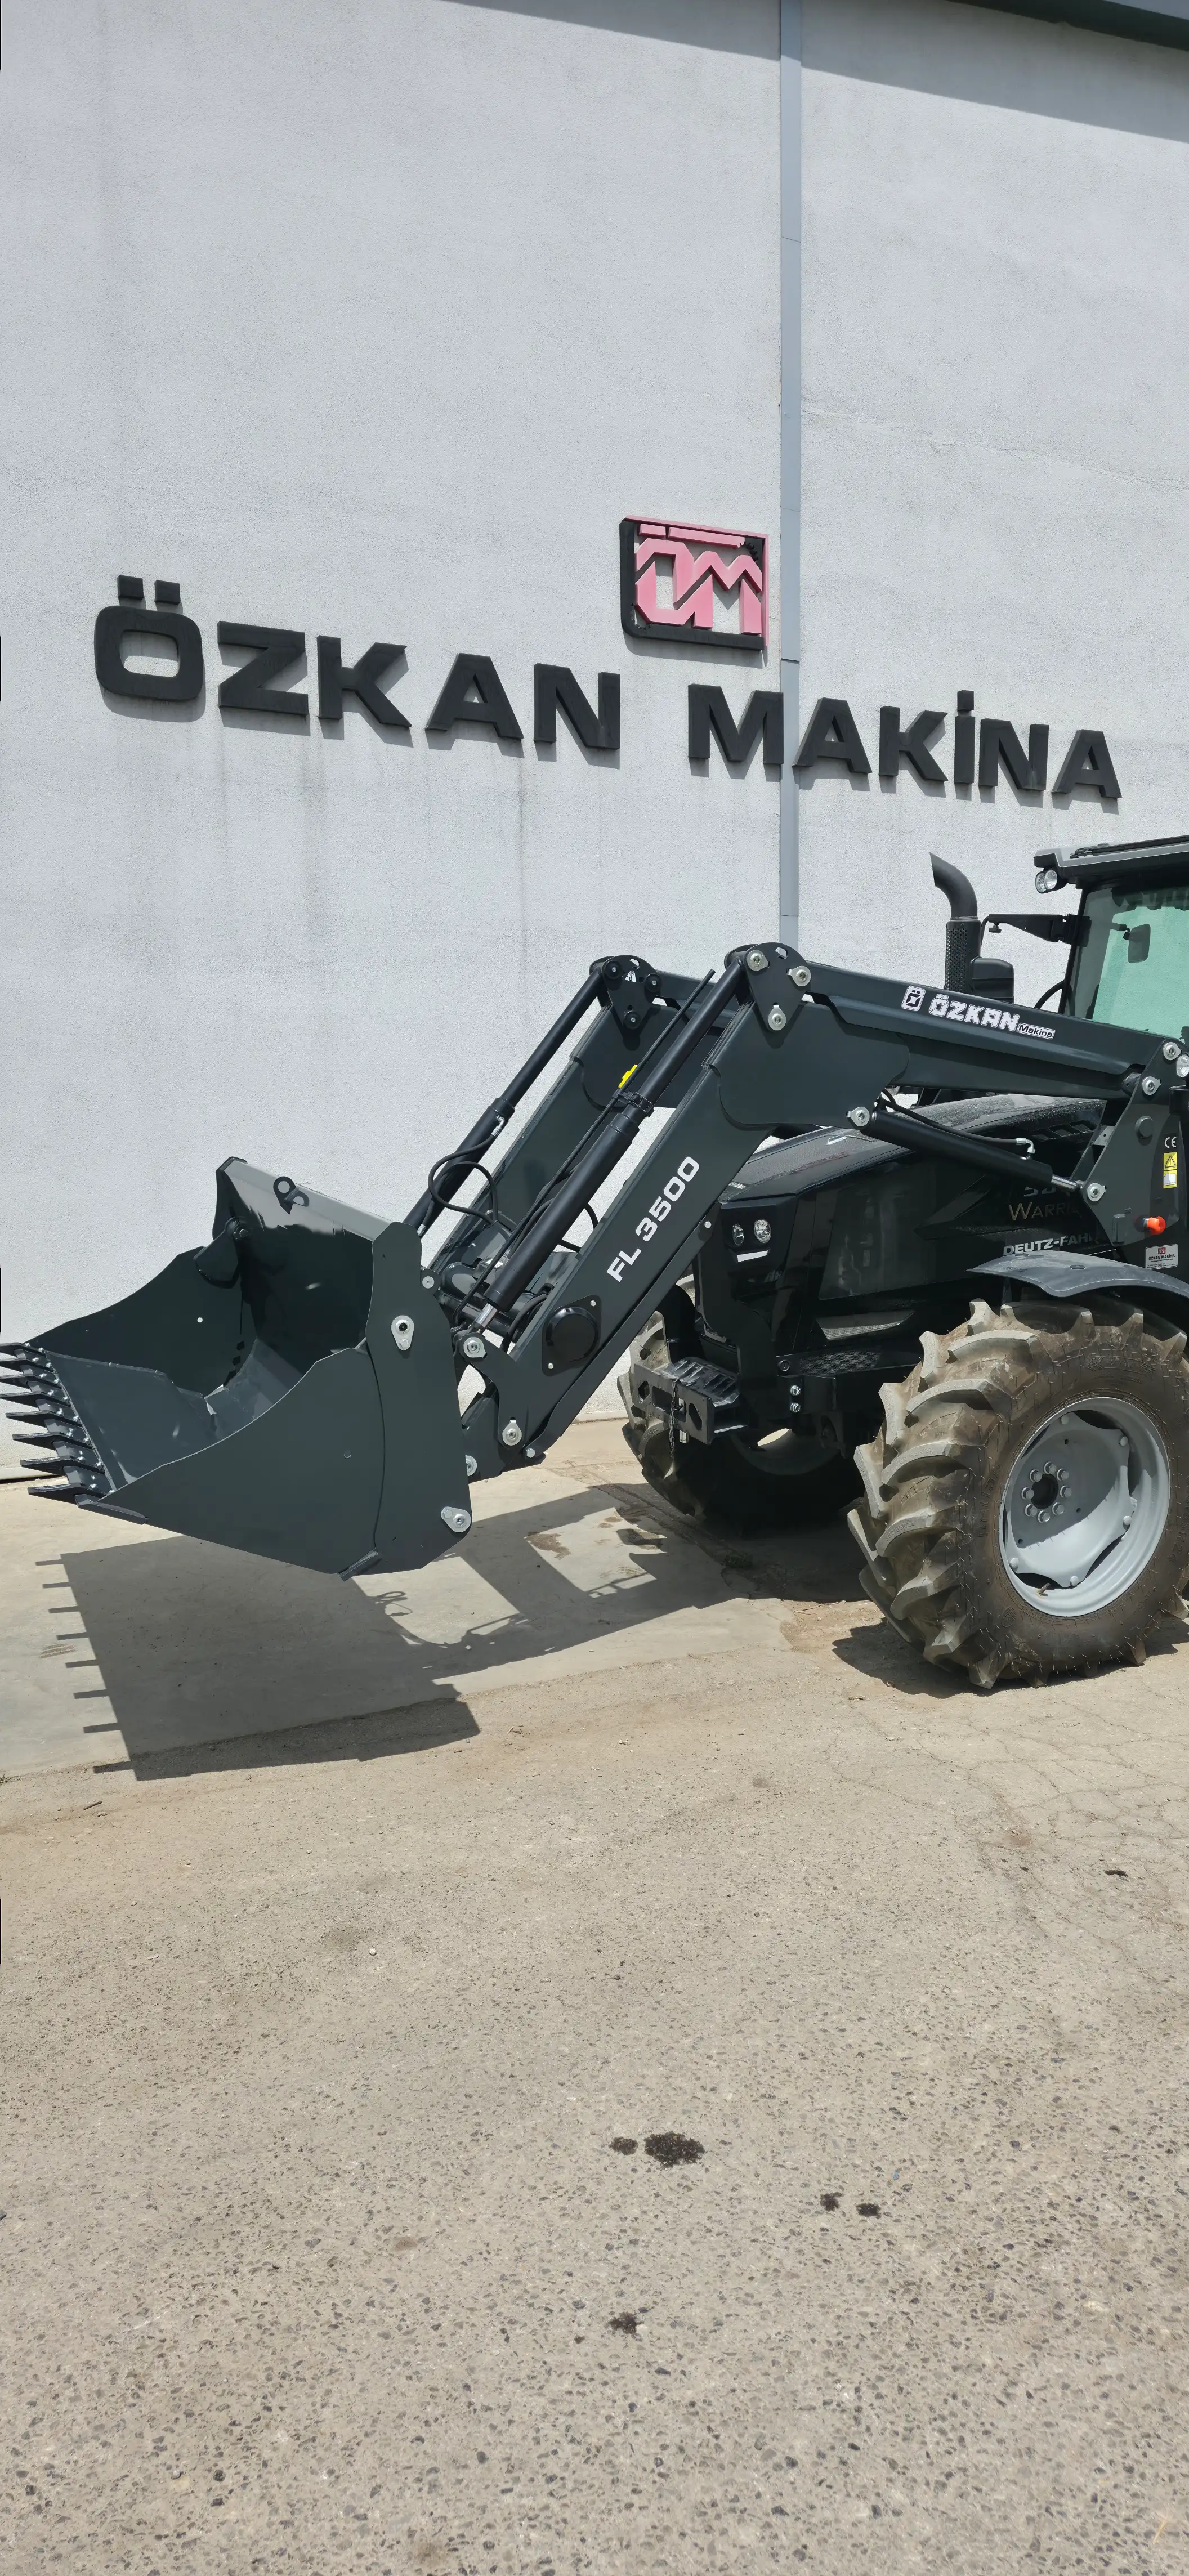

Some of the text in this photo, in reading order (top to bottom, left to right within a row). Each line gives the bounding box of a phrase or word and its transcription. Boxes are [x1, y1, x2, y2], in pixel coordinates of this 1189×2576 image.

[94, 574, 1123, 799] ÖZKAN MAKİNA
[929, 994, 1053, 1039] ÖZKAN Makina
[1164, 1136, 1177, 1148] CE
[607, 1156, 700, 1282] FL 3500
[1008, 1201, 1082, 1220] WARRI
